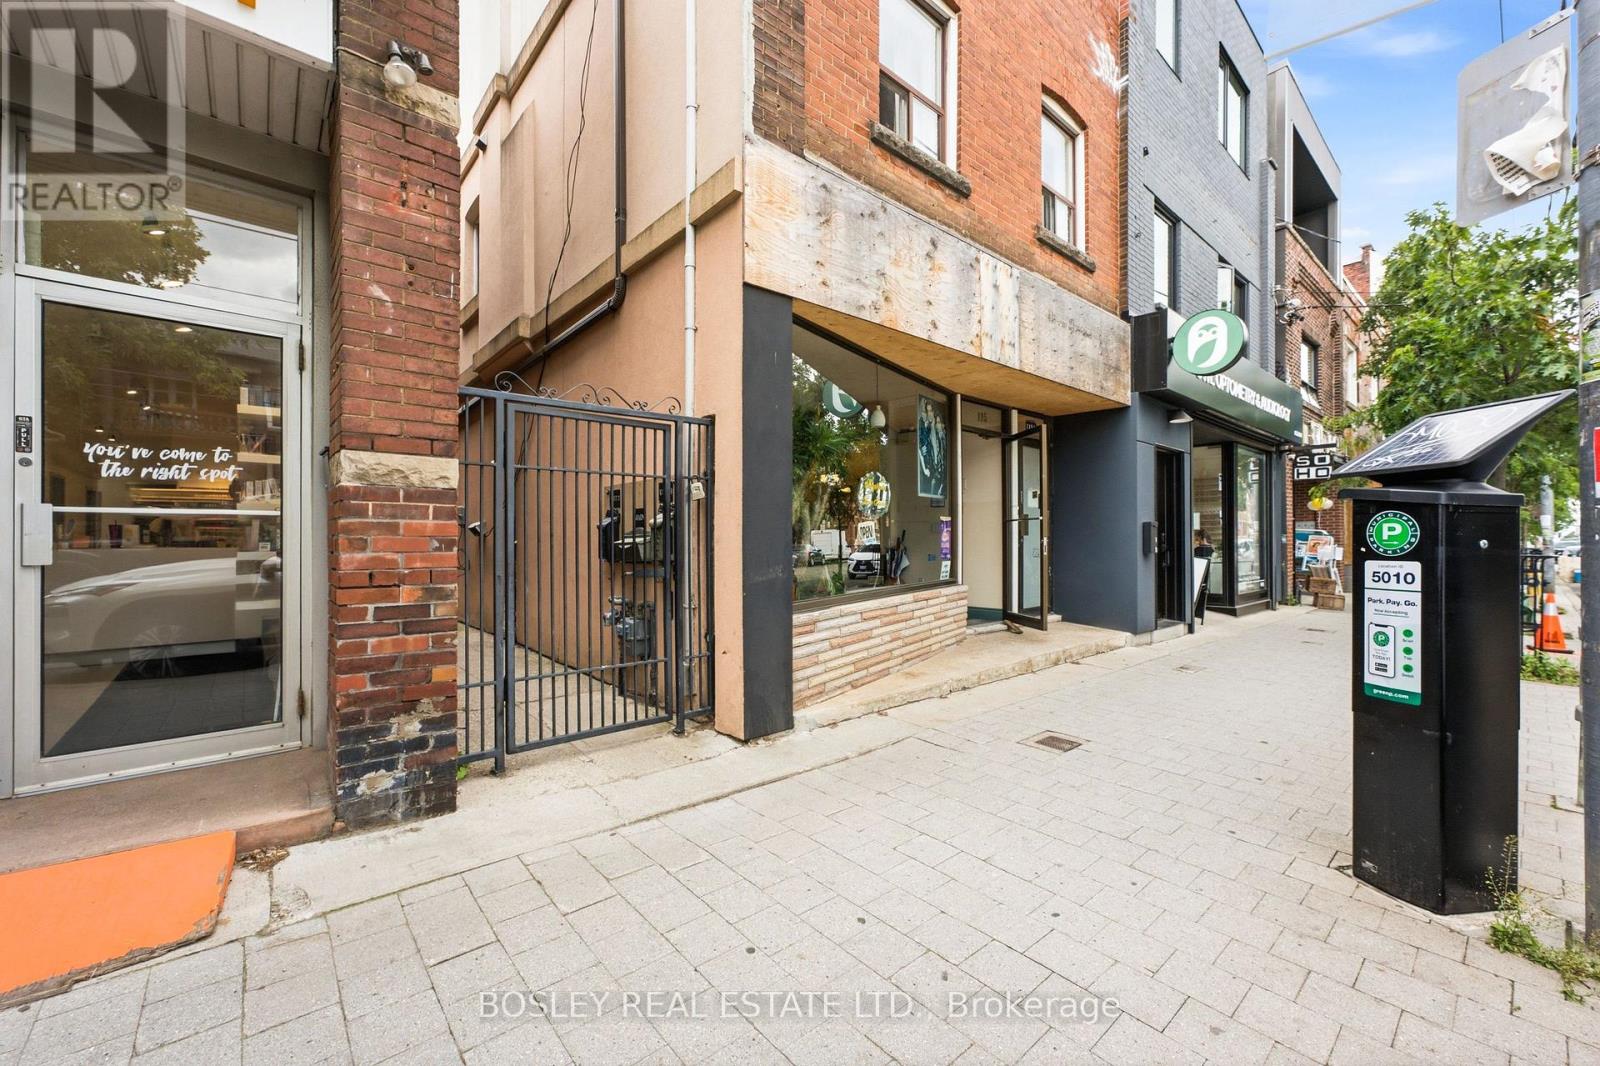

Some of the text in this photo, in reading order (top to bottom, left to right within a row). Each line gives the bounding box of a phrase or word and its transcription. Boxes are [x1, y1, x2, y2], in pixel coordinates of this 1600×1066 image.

[160, 448, 207, 462] come
[212, 447, 233, 463] to
[98, 459, 244, 482] the right spot
[1382, 522, 1403, 540] P
[1371, 570, 1416, 585] 5010
[1367, 597, 1418, 607] Park. Pay. Go.
